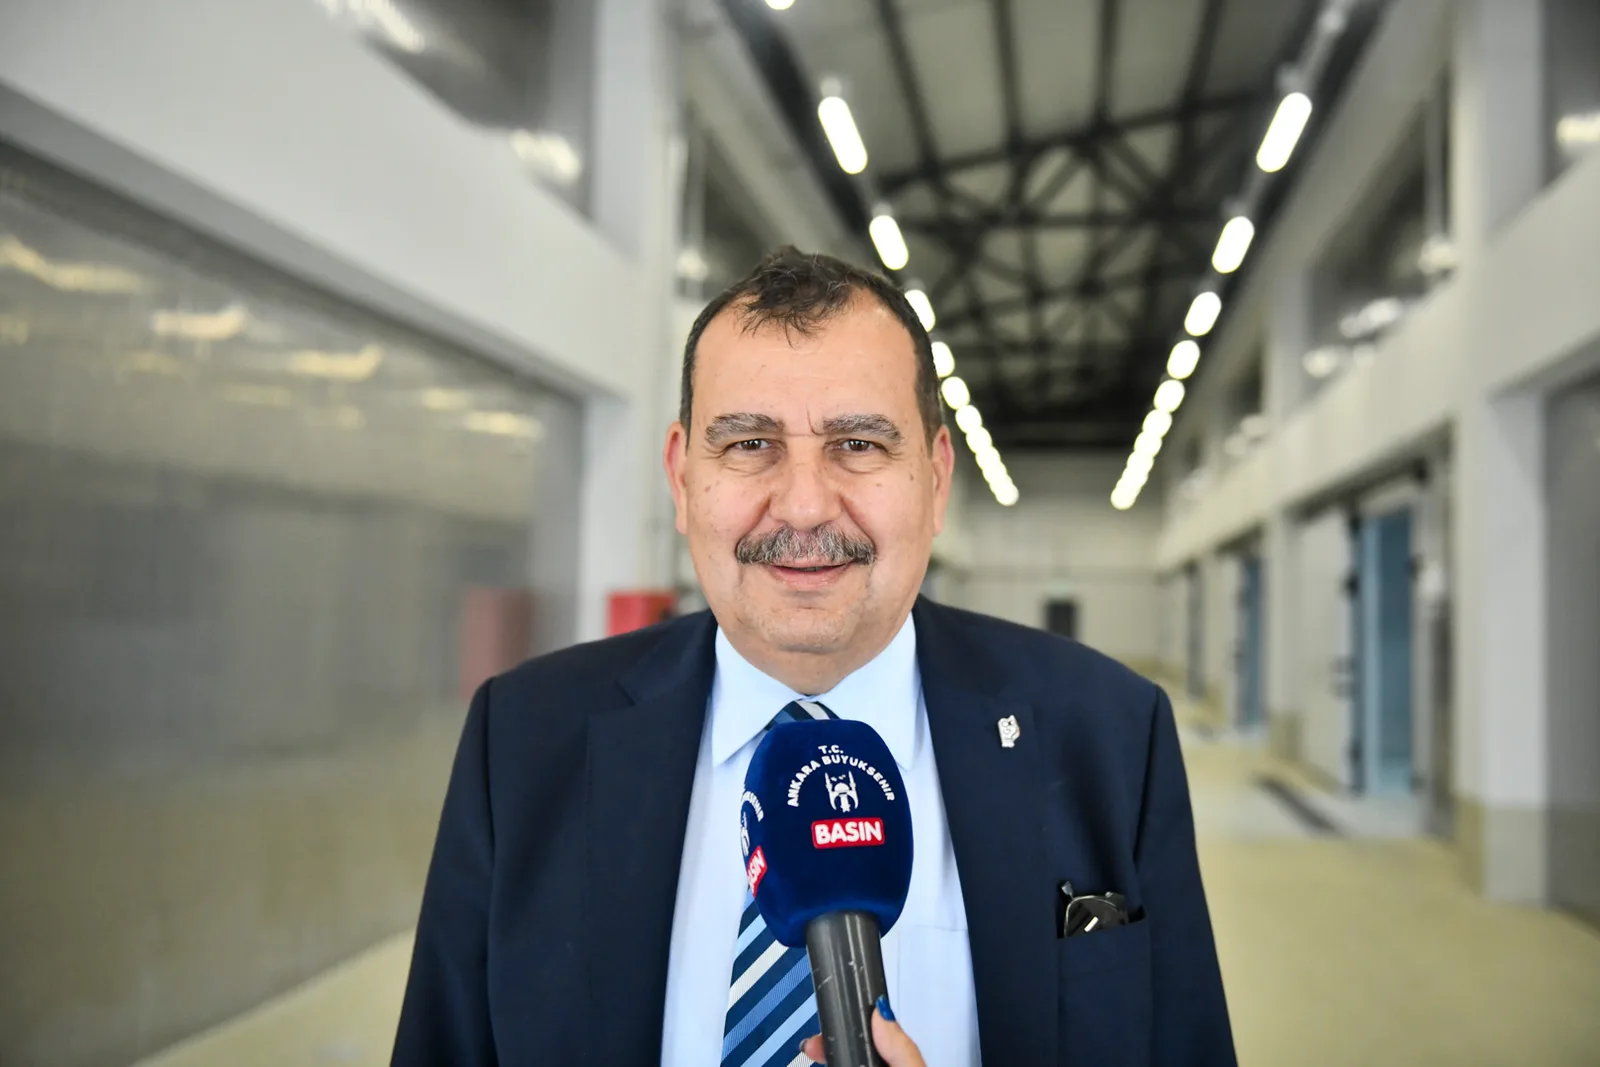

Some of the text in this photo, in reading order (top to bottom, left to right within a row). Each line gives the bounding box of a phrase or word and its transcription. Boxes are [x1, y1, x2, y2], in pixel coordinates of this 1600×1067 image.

[818, 745, 844, 754] T.C.
[787, 760, 821, 807] ANKARA
[815, 821, 882, 845] BASIN
